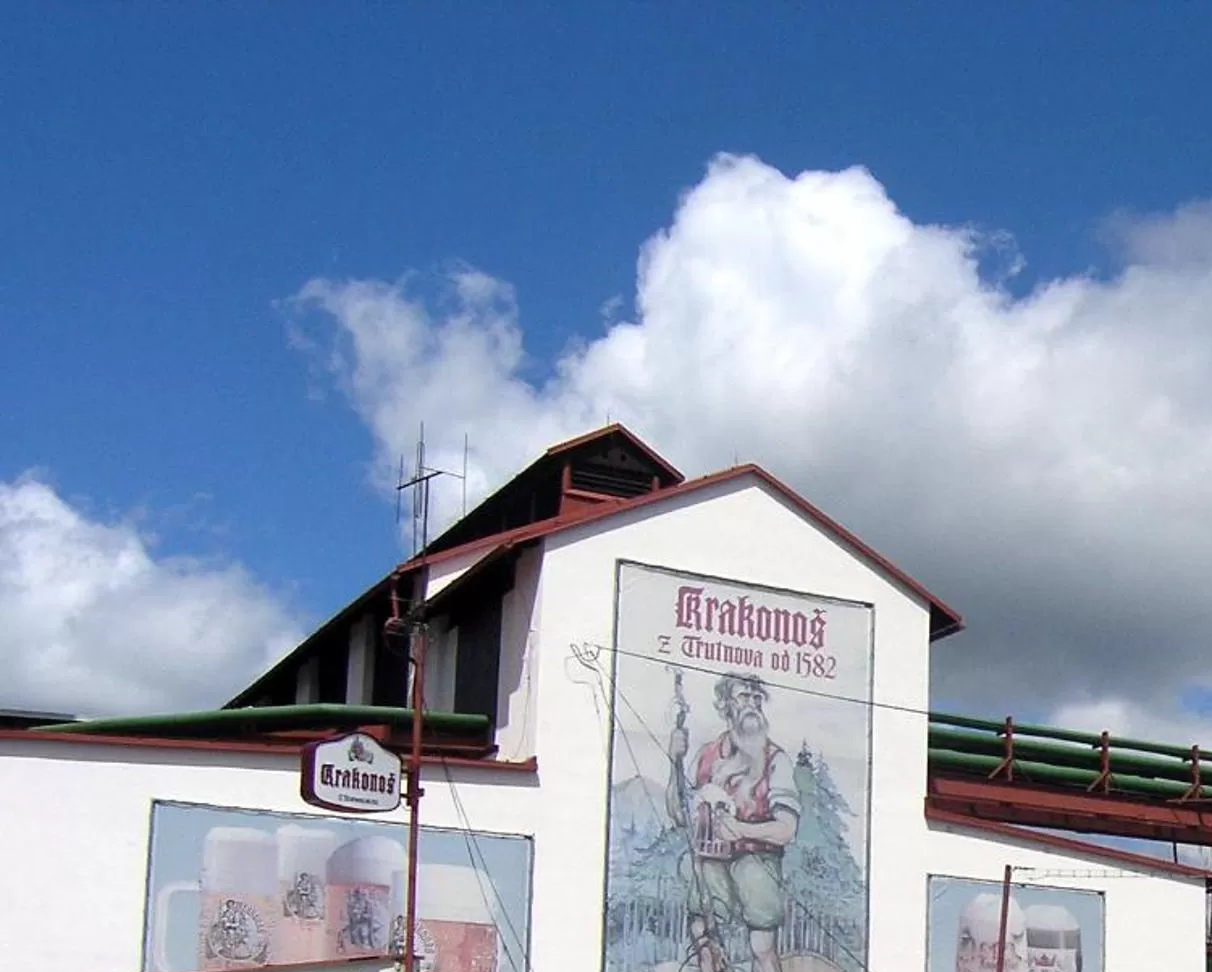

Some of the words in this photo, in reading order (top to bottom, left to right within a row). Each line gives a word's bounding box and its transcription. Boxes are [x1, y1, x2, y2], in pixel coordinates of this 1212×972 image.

[676, 586, 828, 650] Krakonoš
[681, 635, 763, 669] Trutnova
[771, 652, 790, 673] od
[796, 651, 837, 680] 1582
[321, 764, 396, 795] Krakonoš
